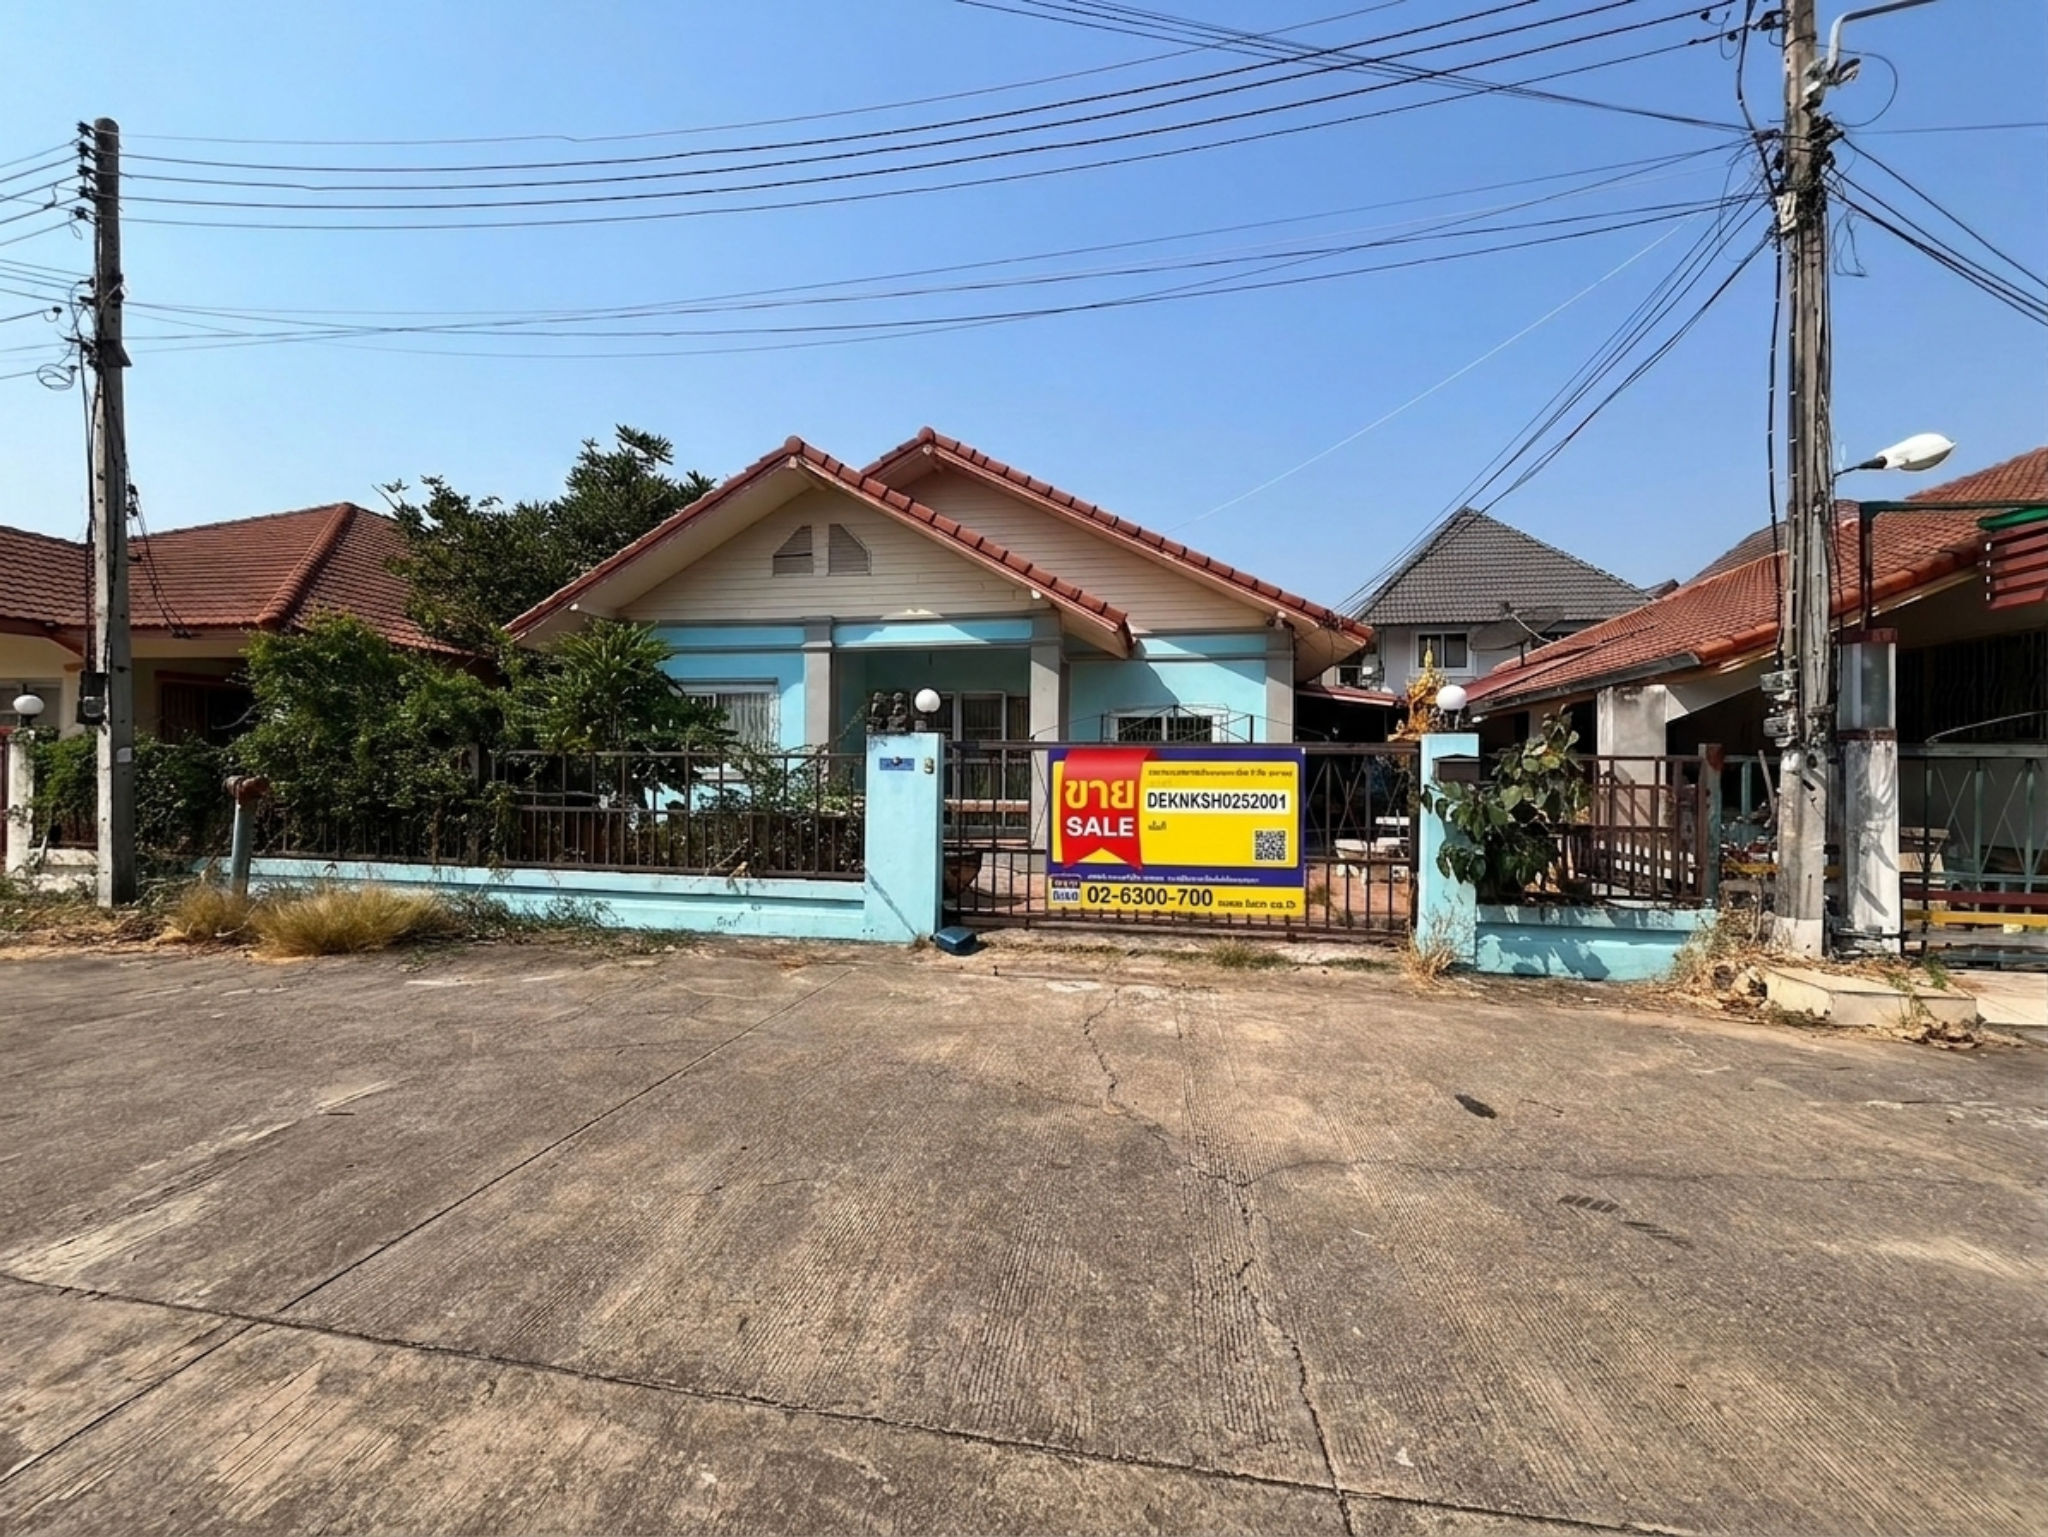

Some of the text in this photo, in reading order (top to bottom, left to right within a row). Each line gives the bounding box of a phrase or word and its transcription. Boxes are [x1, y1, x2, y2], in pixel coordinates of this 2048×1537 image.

[1065, 780, 1135, 809] ขาย
[1147, 792, 1287, 809] DEKNKSH0252001
[1066, 816, 1135, 837] SALE
[1087, 885, 1213, 907] 02-6300-700
